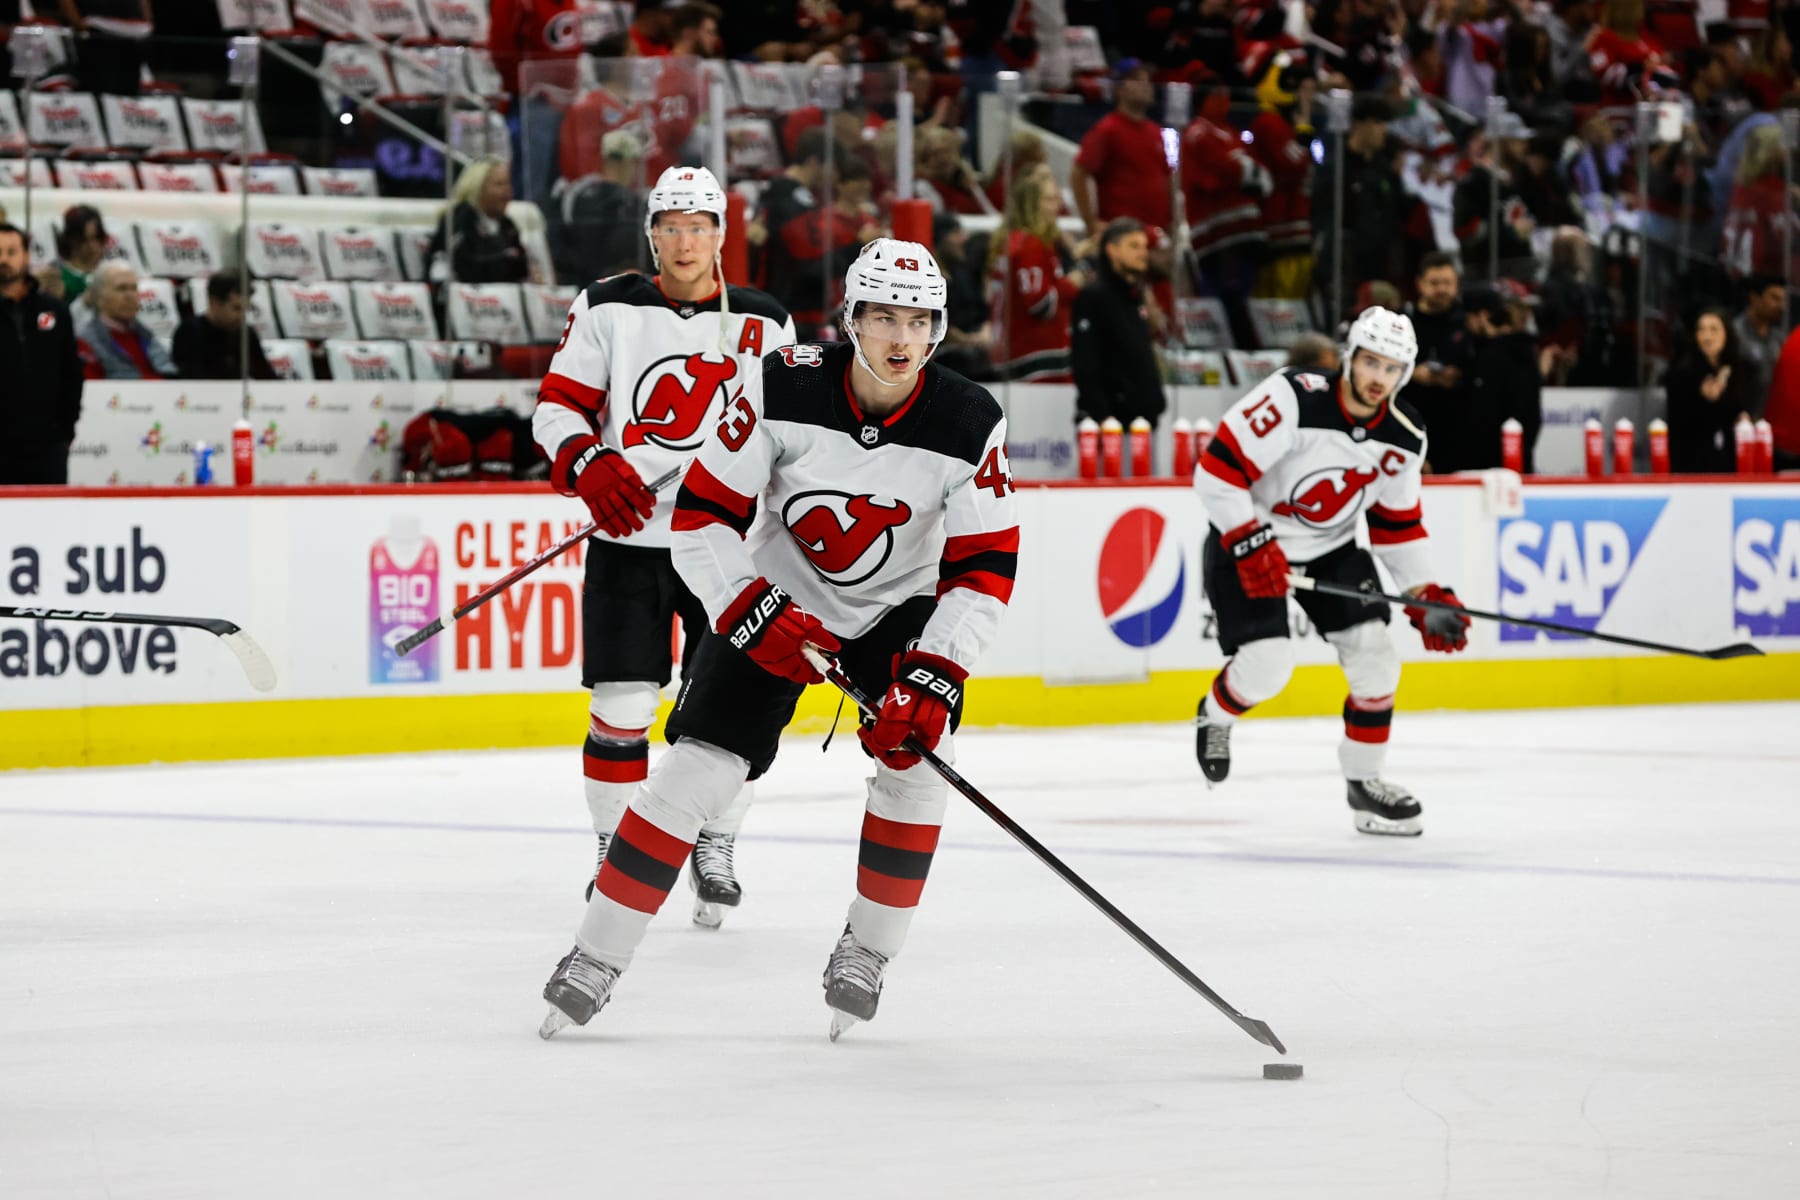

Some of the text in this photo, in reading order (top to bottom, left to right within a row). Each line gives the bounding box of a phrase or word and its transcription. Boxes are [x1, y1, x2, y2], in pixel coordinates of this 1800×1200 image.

[894, 257, 919, 272] 43
[738, 317, 763, 357] A
[1242, 394, 1282, 438] 13
[973, 441, 1016, 498] 4
[1380, 449, 1406, 476] C
[9, 525, 166, 595] a sub
[456, 521, 582, 569] CLEAN
[1500, 519, 1630, 617] SAP
[378, 573, 432, 608] BIO
[729, 584, 786, 649] BAUER
[0, 617, 177, 678] above
[455, 581, 584, 671] HYD
